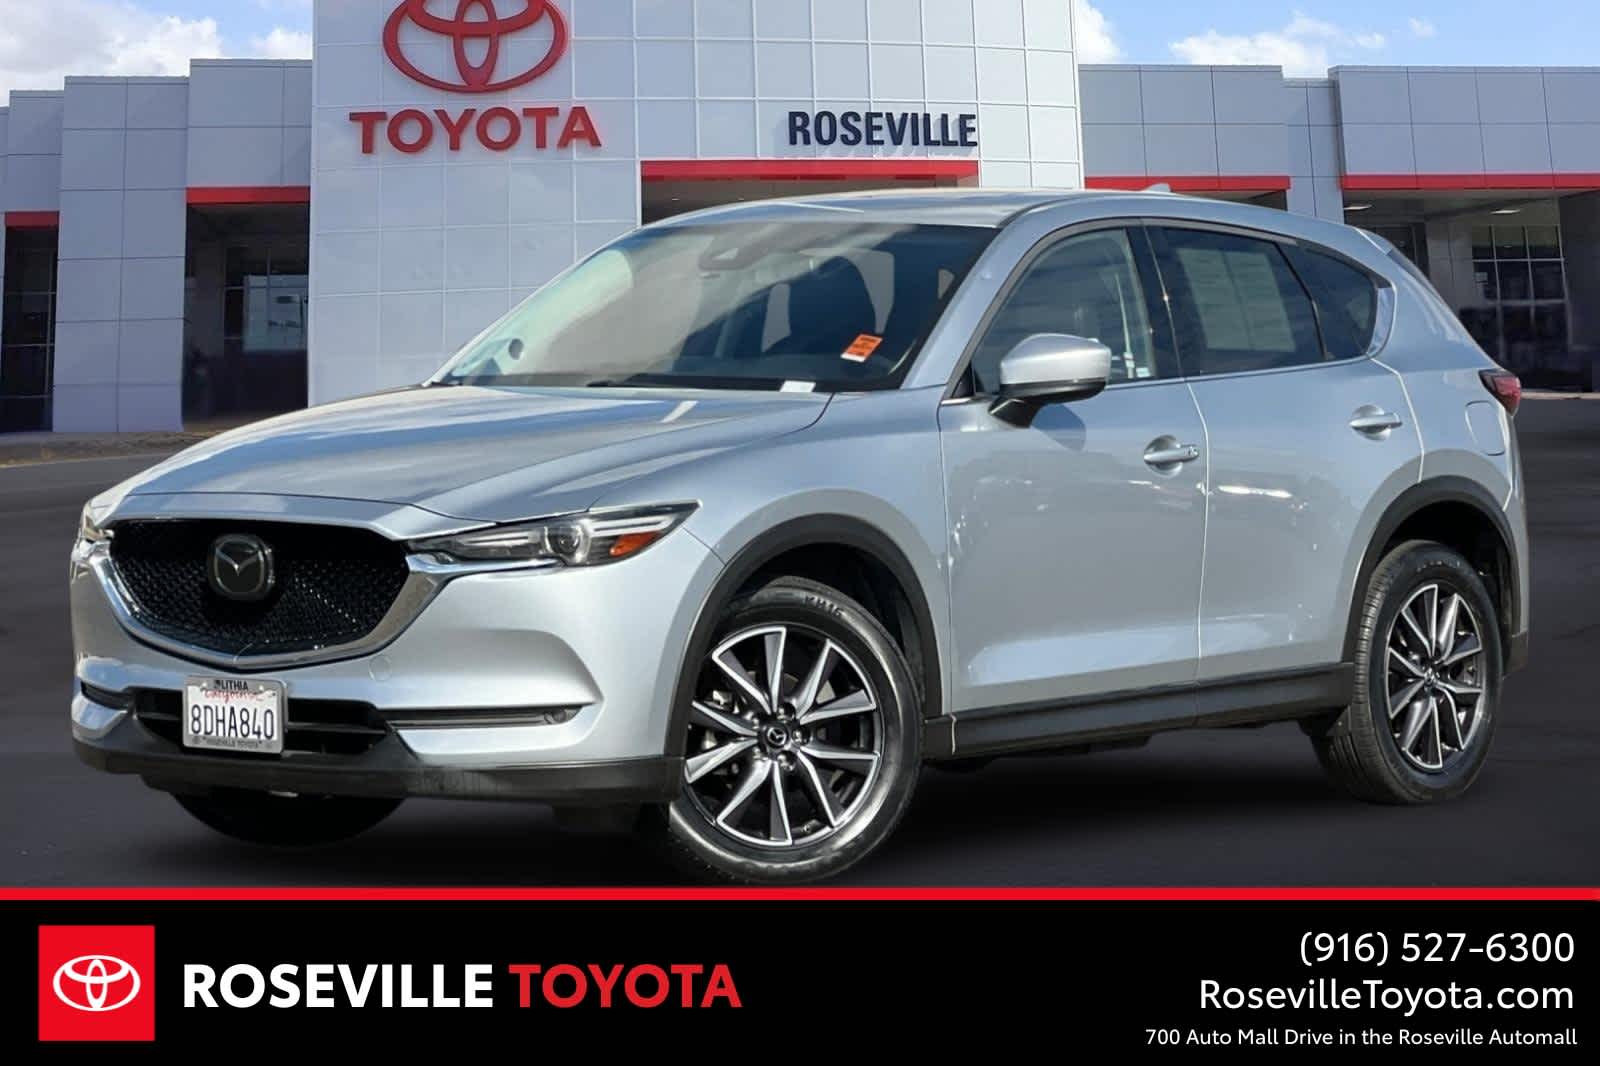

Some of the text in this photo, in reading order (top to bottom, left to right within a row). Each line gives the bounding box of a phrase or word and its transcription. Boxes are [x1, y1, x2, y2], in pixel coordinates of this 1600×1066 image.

[349, 106, 602, 154] TOYOTA
[788, 110, 979, 147] ROSEVILLE
[221, 679, 249, 691] LITHIA
[191, 704, 274, 740] 8DHA840
